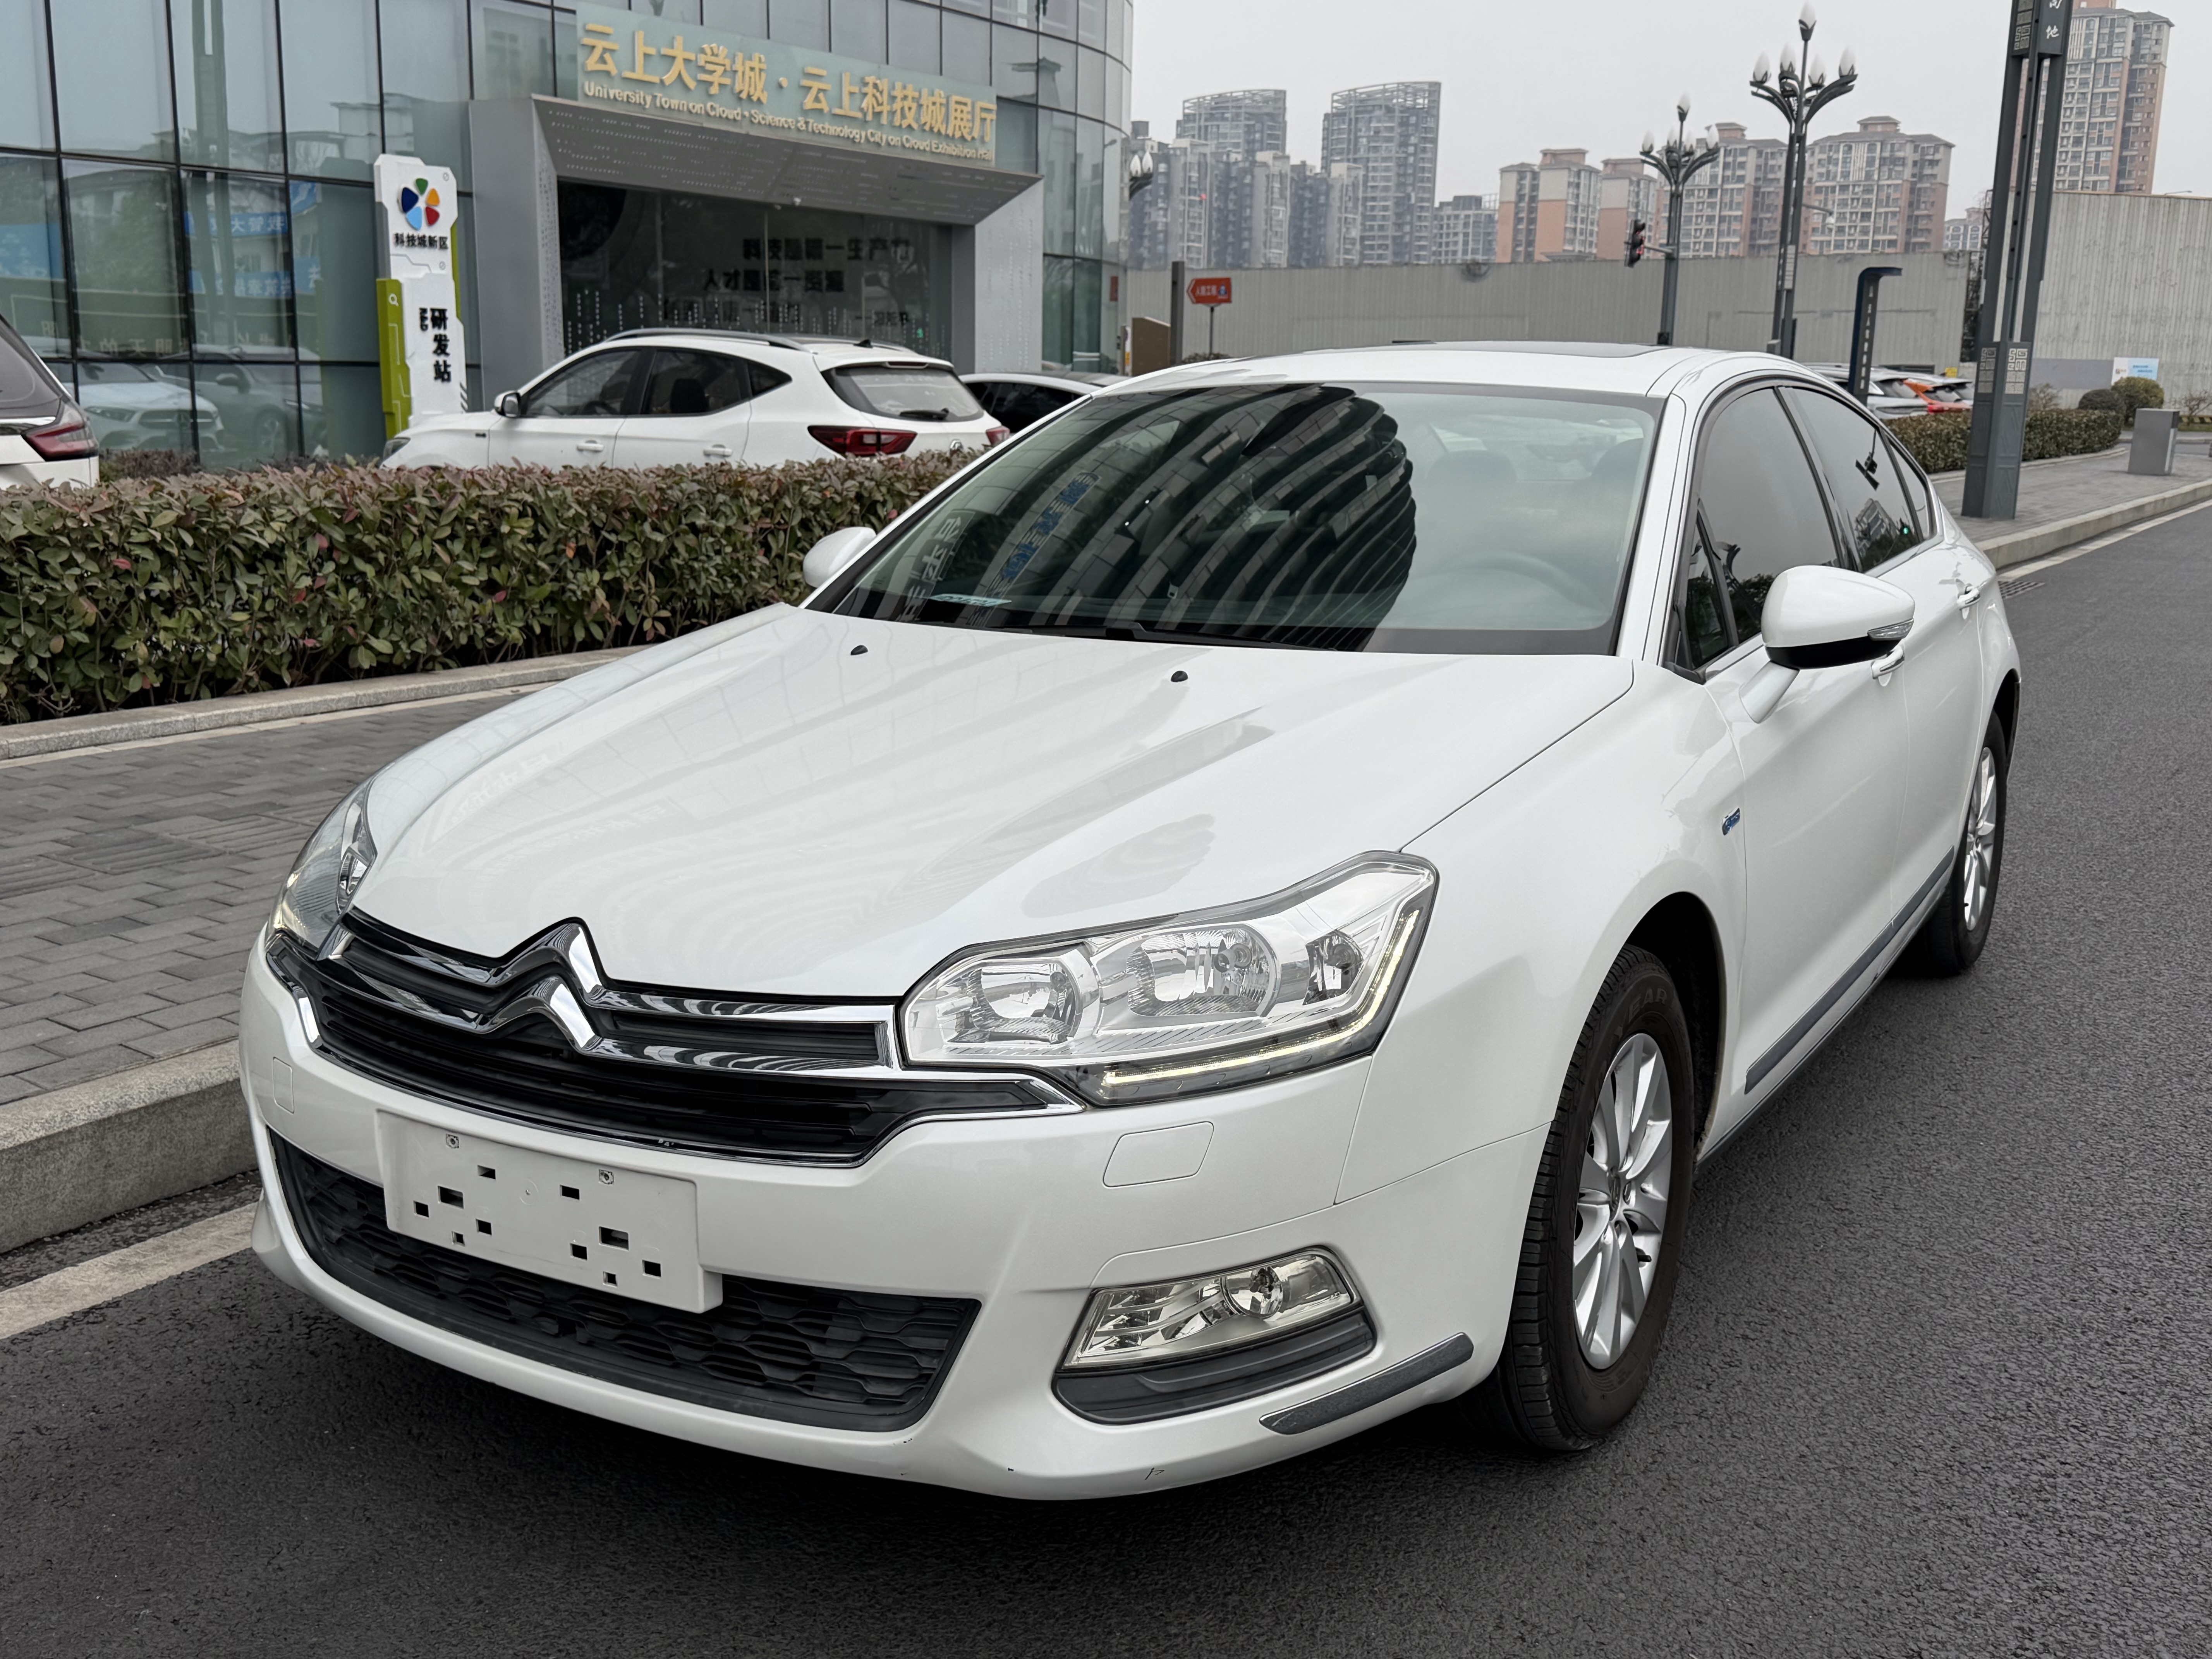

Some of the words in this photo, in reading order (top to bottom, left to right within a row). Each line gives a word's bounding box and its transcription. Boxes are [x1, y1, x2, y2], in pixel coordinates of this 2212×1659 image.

[584, 81, 653, 109] University
[653, 93, 687, 112] Town
[689, 101, 705, 115] on
[706, 101, 742, 121] Cloud
[750, 109, 796, 129] Science
[797, 116, 806, 131] &
[805, 118, 867, 143] Technology
[867, 129, 887, 146] City
[888, 136, 901, 146] on
[903, 135, 930, 151] Cloud
[931, 140, 976, 158] Exhibition
[393, 232, 448, 250] 科技城新区
[430, 308, 452, 382] 研发站
